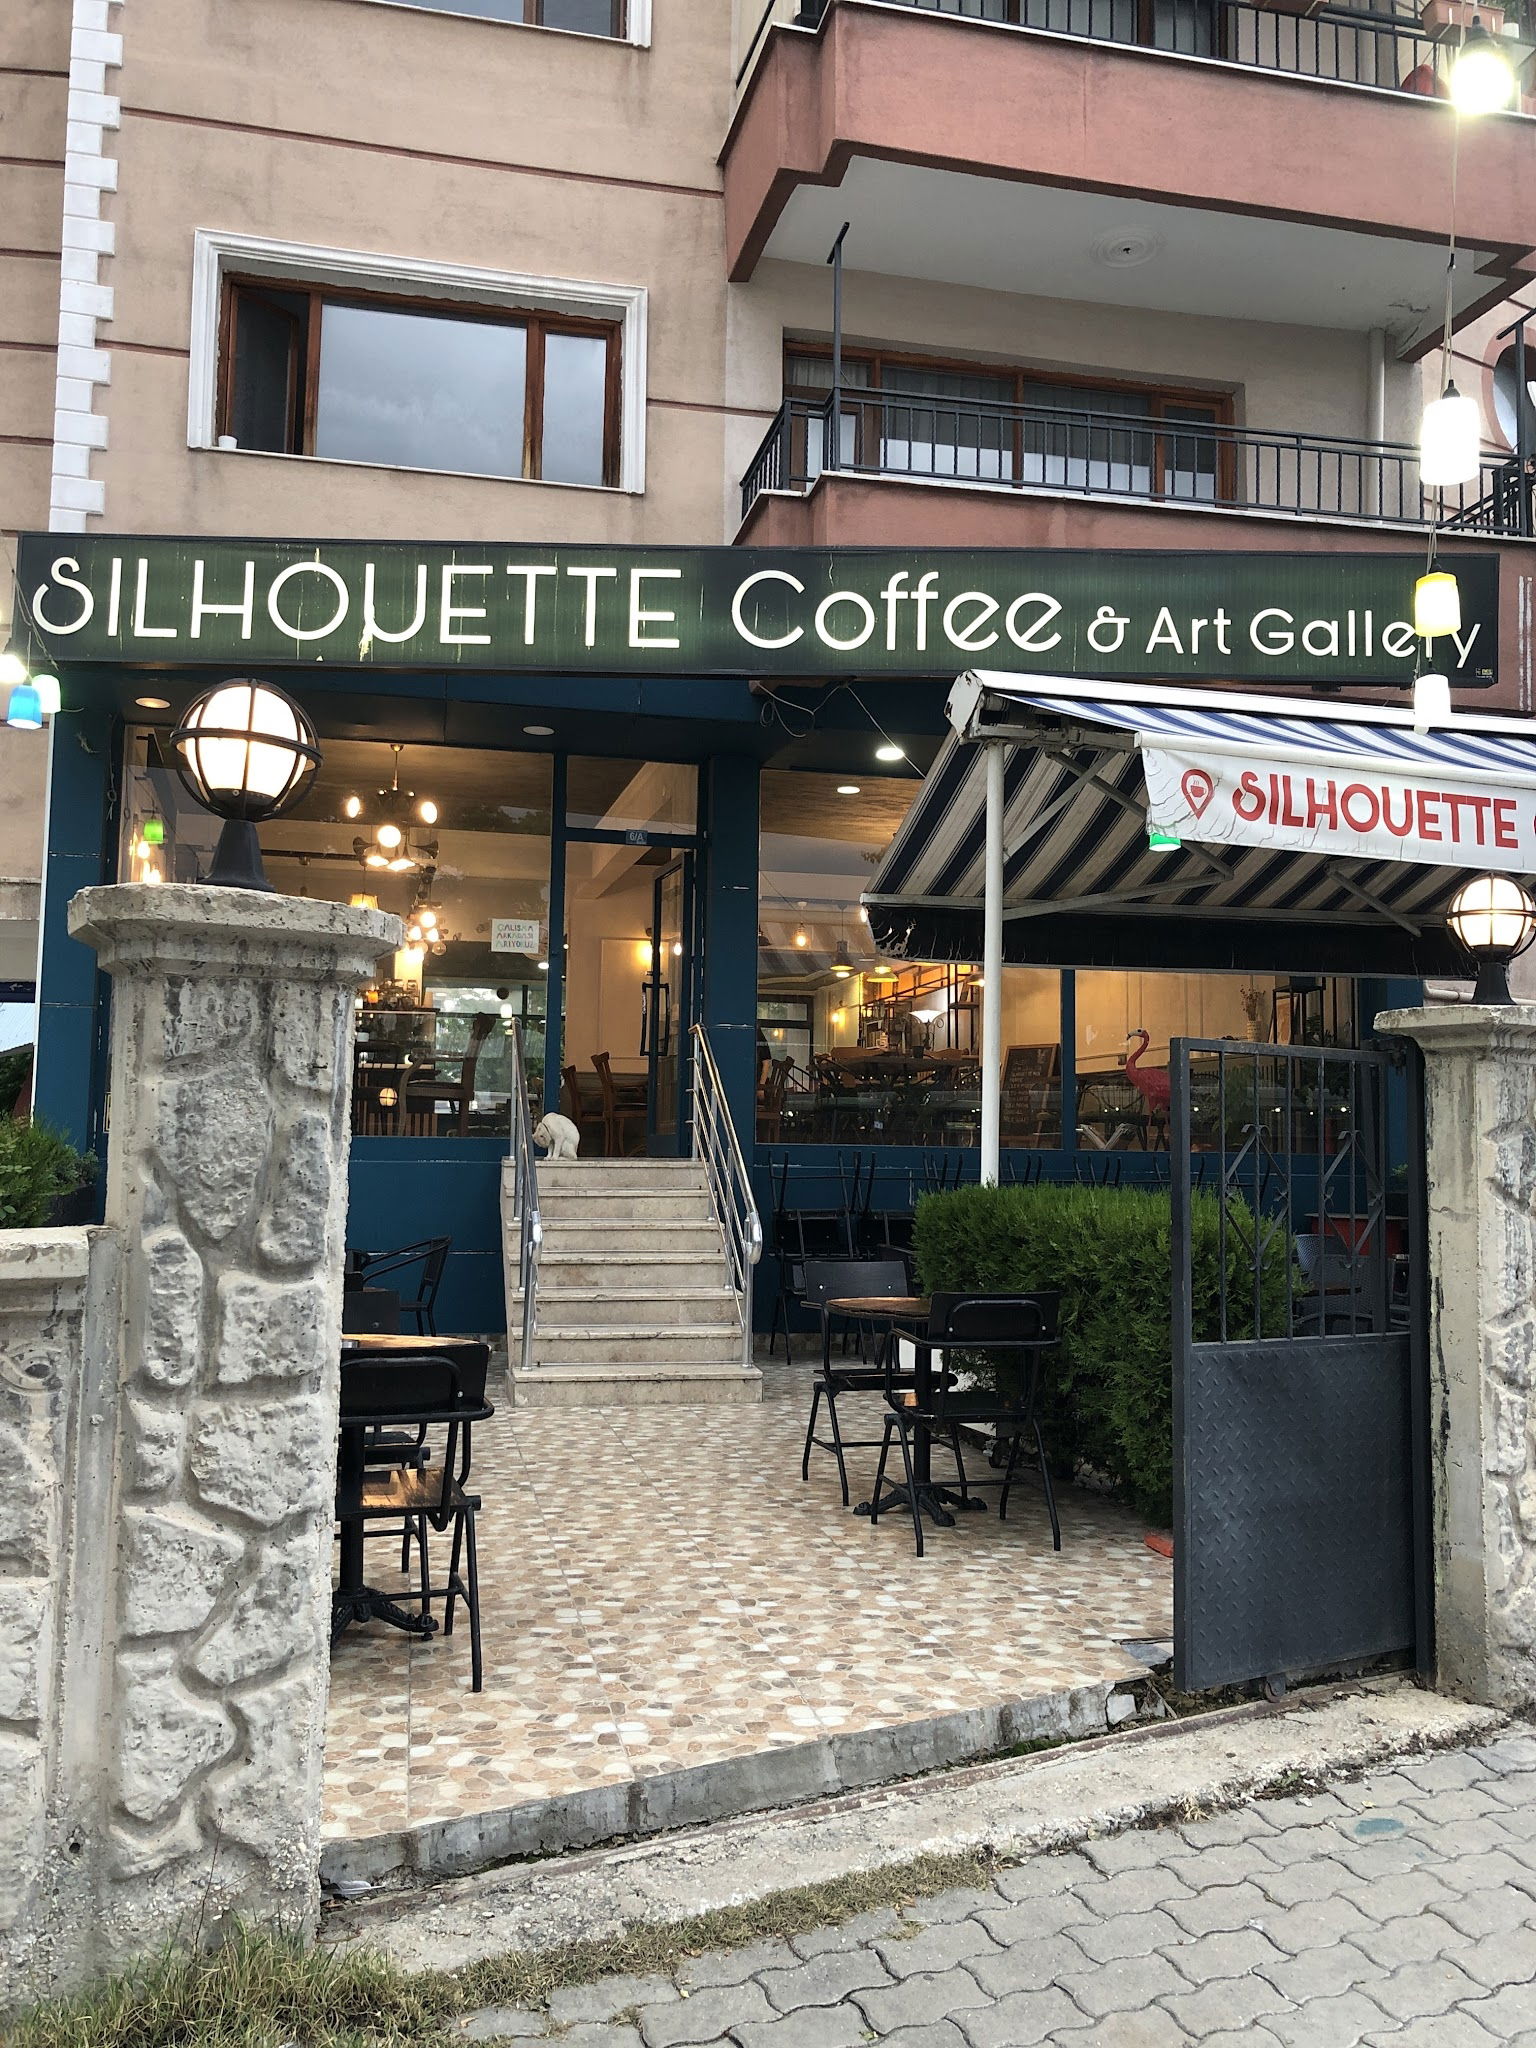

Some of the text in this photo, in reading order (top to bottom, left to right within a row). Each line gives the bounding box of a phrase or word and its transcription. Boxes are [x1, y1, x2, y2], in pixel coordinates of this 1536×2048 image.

[32, 556, 683, 649] SILHOUETTE
[731, 569, 1063, 653] Coffee
[1087, 605, 1130, 654] &
[1145, 606, 1231, 656] Art
[1232, 770, 1519, 849] SILHOUETTE
[495, 940, 535, 949] ARIYOUZ
